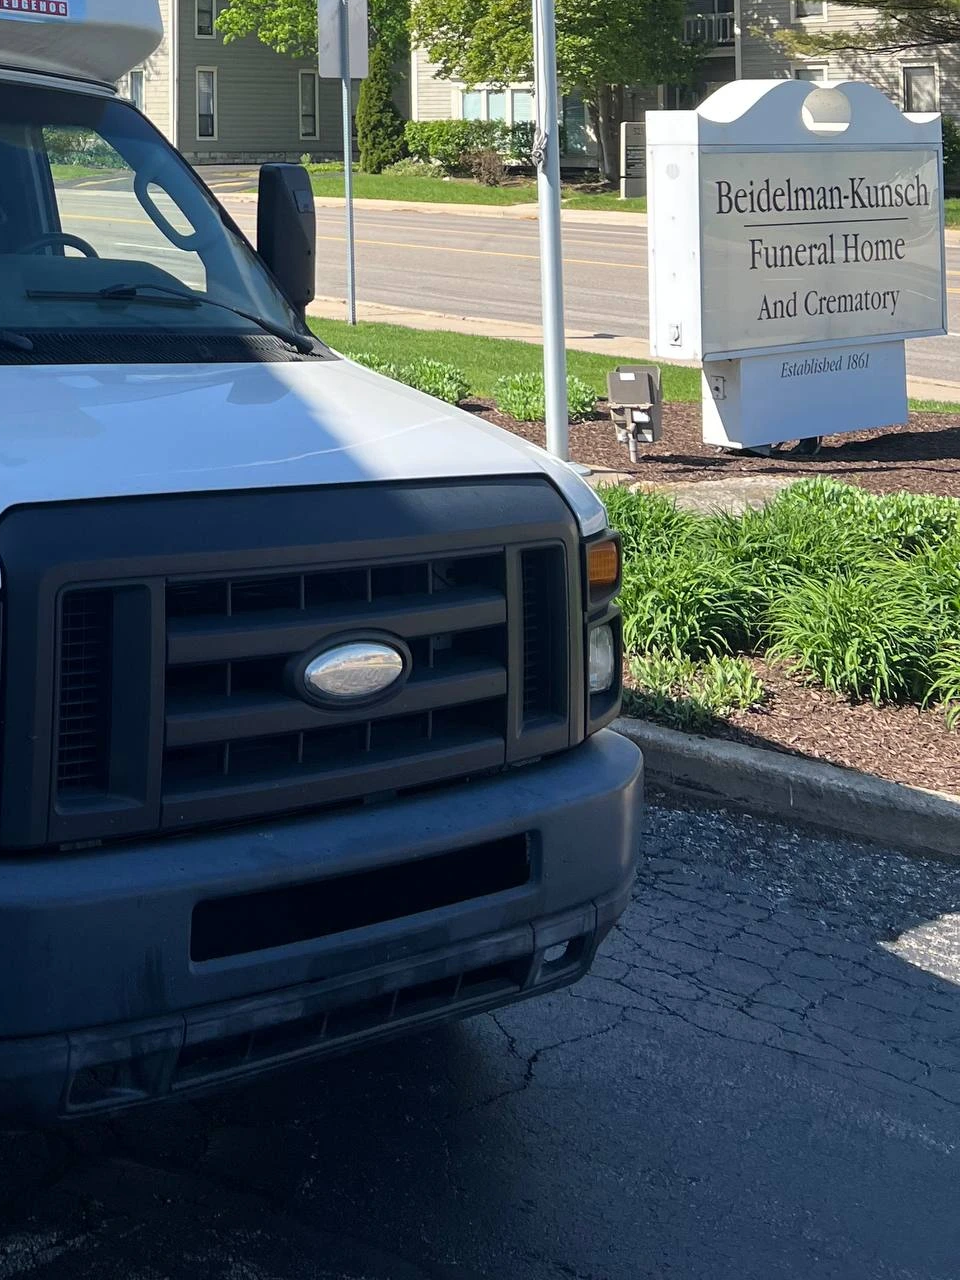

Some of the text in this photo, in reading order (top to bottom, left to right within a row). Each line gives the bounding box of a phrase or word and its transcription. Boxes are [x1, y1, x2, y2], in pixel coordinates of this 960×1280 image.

[715, 174, 930, 215] Beidelman-Kunsch
[748, 233, 906, 270] Funeral Home
[757, 290, 900, 320] And Crematory
[780, 352, 870, 379] Established 1861
